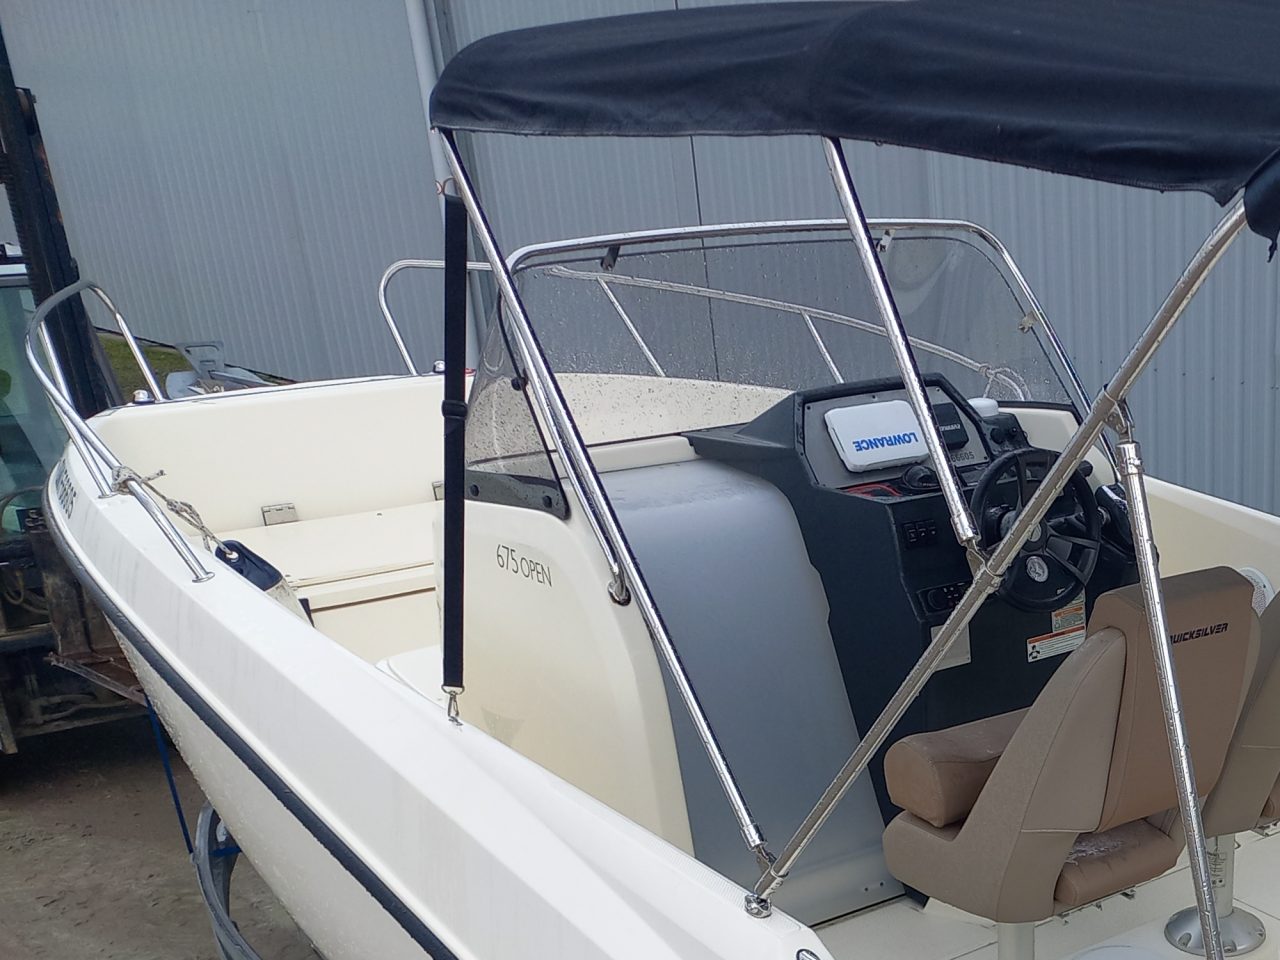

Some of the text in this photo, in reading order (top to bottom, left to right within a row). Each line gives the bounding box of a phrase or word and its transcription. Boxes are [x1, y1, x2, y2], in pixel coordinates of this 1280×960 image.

[852, 432, 919, 452] LOWRANCE
[496, 543, 552, 588] 675 OPEN
